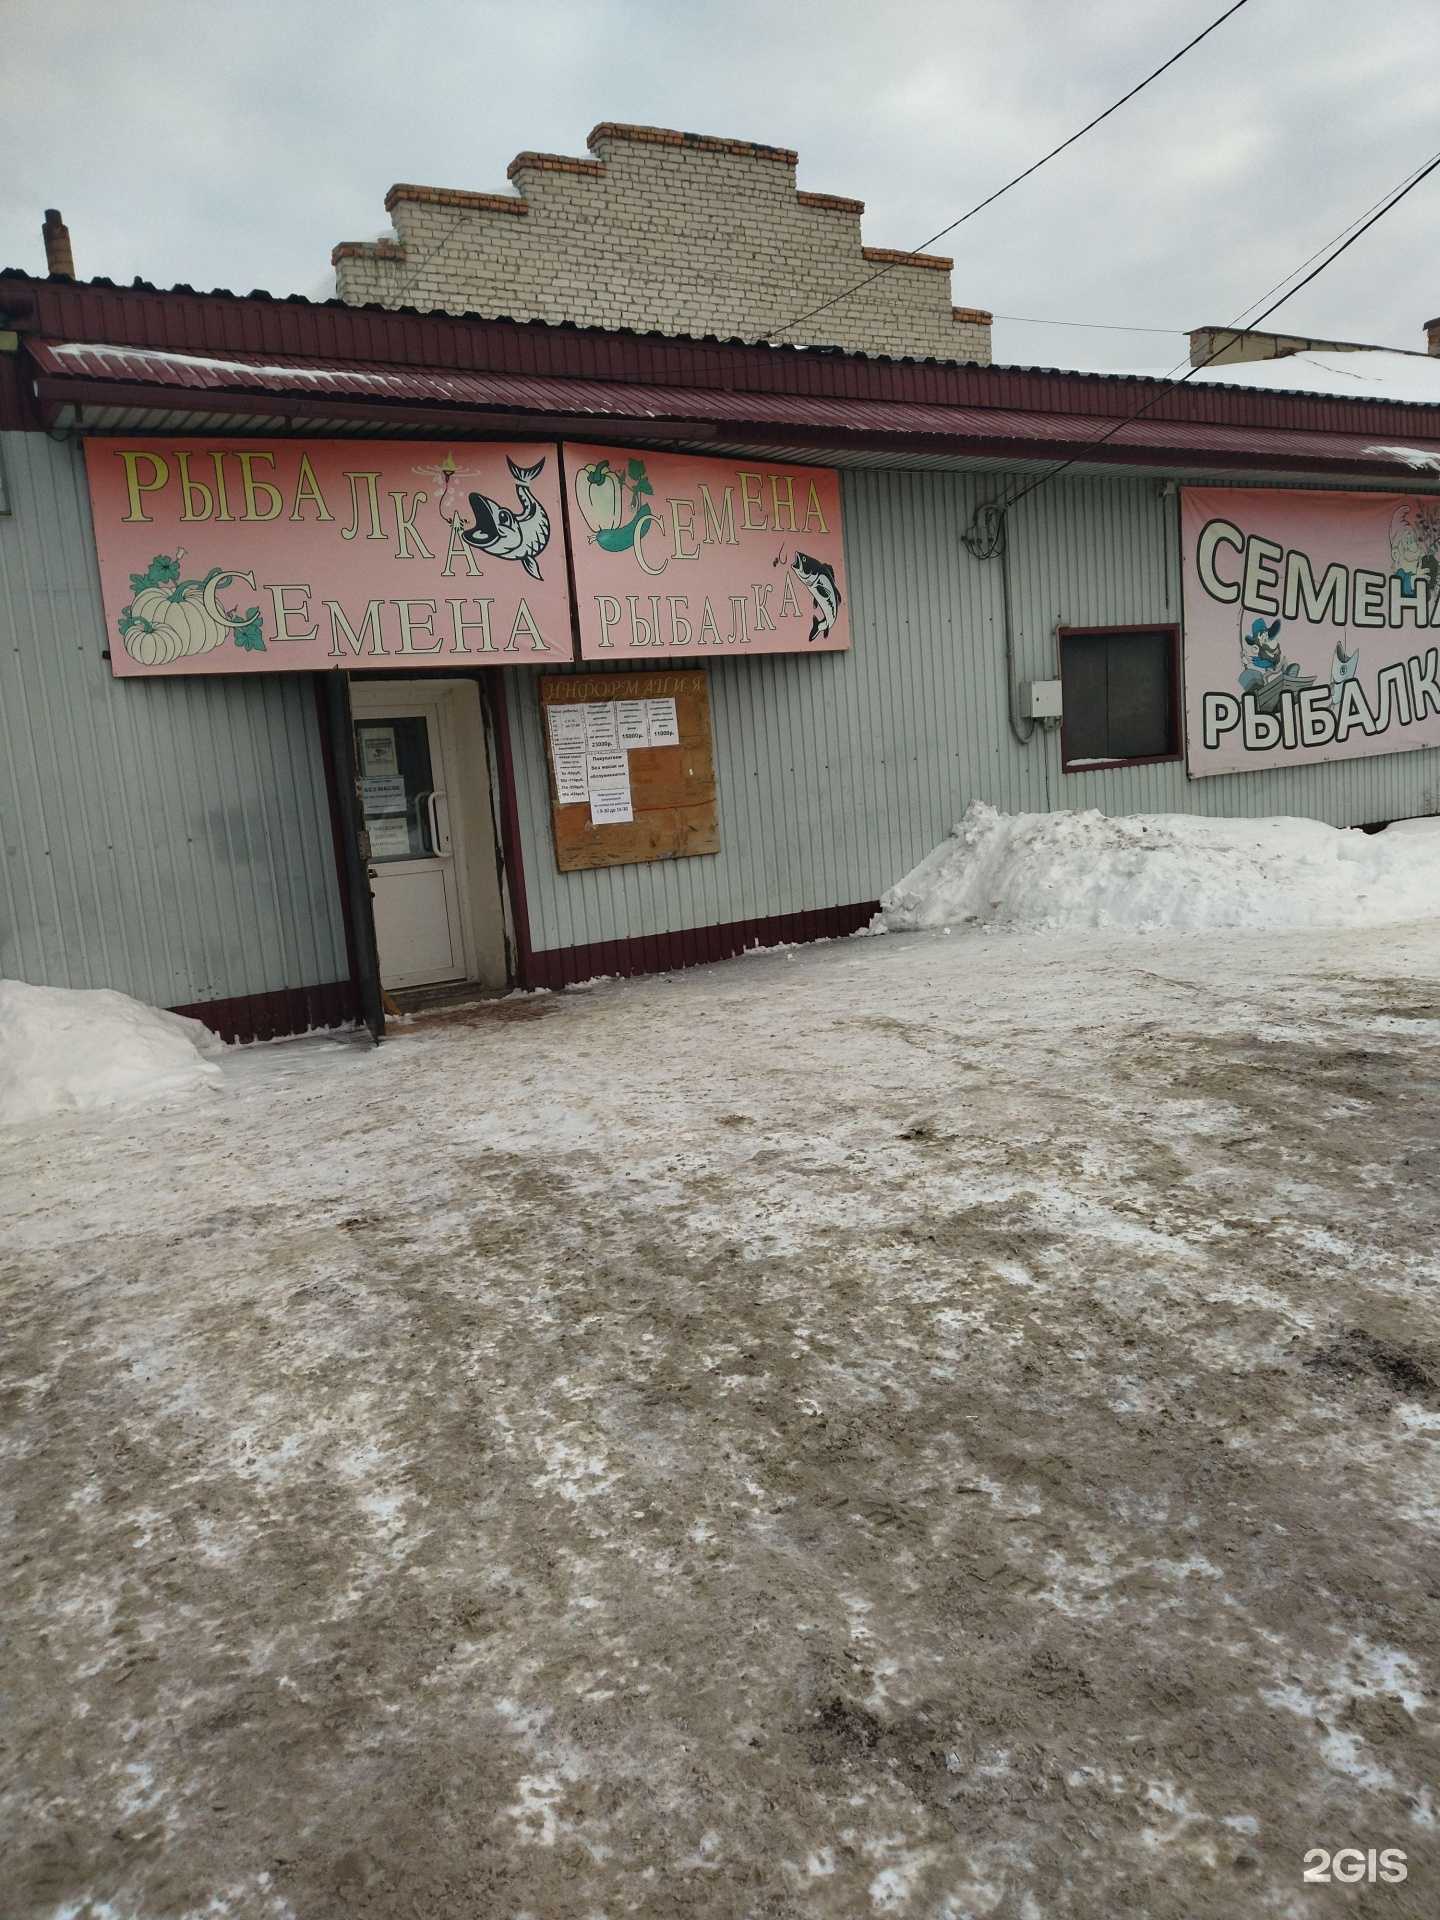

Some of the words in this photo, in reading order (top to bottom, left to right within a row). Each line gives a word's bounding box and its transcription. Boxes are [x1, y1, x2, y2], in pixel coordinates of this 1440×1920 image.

[113, 450, 484, 577] РЫБАЛКА
[633, 471, 832, 576] СЕМЕНА
[202, 569, 551, 657] СЕМЕНА
[593, 570, 804, 648] РЫБАЛКА
